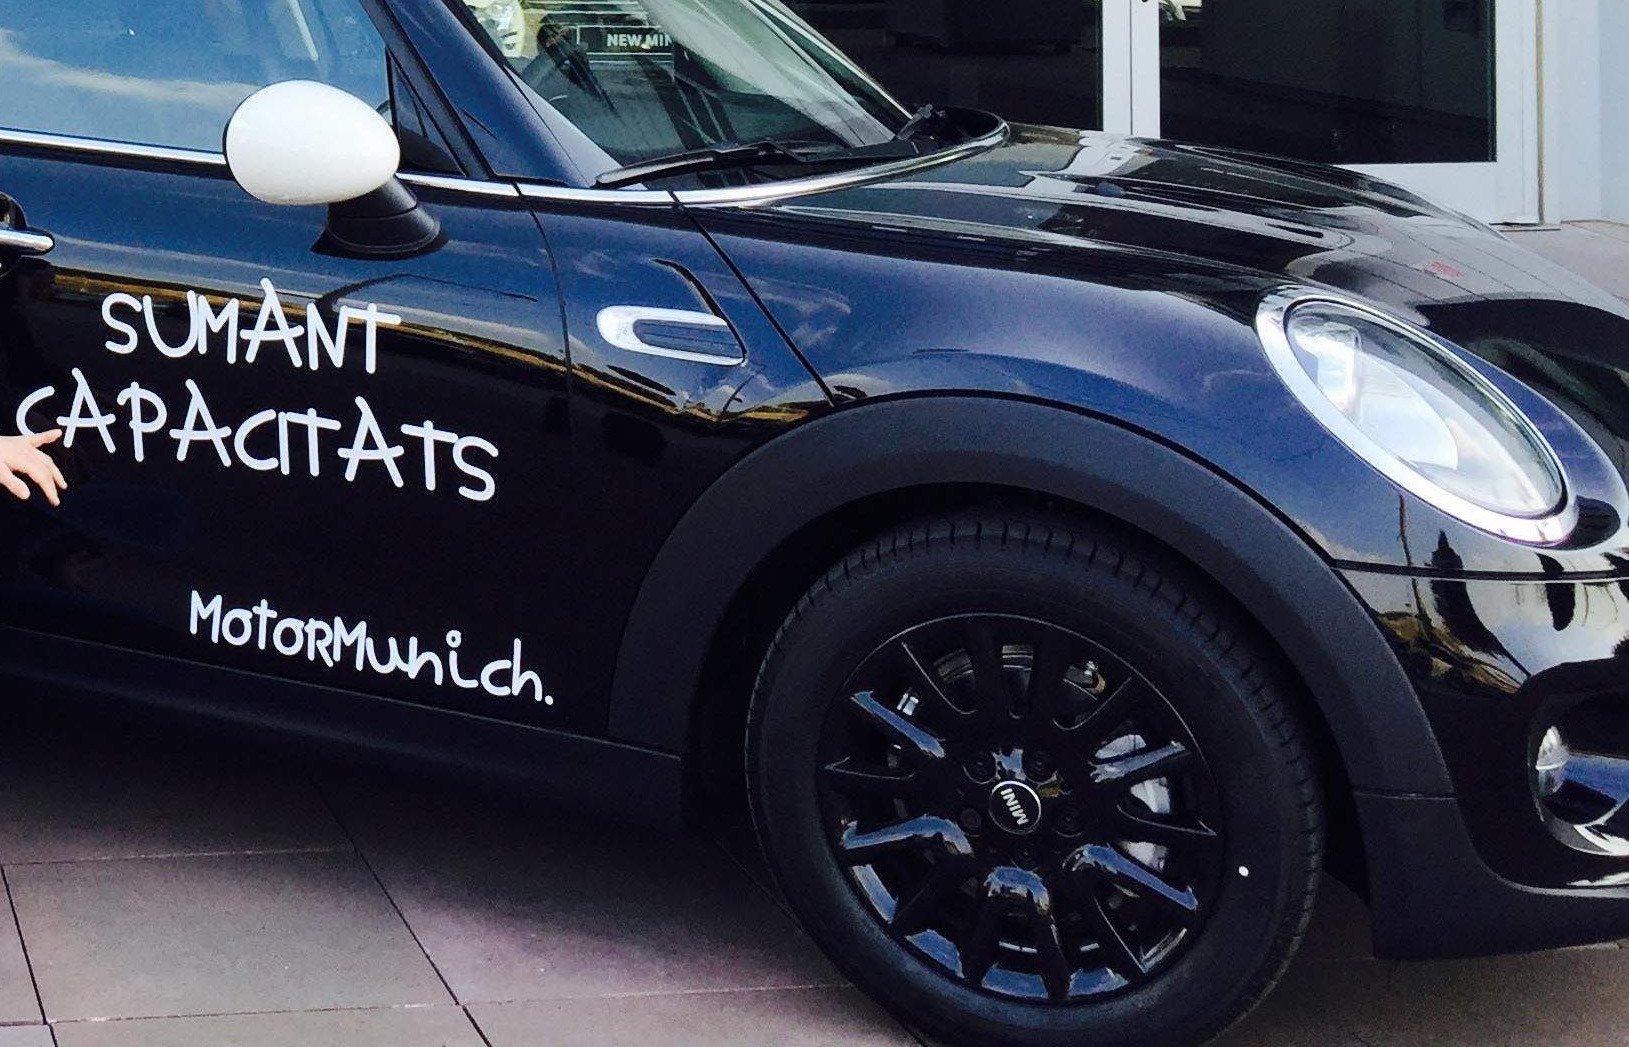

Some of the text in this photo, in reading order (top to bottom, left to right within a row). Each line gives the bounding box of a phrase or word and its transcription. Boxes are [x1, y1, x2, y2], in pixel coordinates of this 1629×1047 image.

[606, 33, 673, 47] NEW MIN
[101, 277, 402, 374] SUMANT
[15, 367, 499, 502] CAPACITATS
[1000, 788, 1029, 825] MINI
